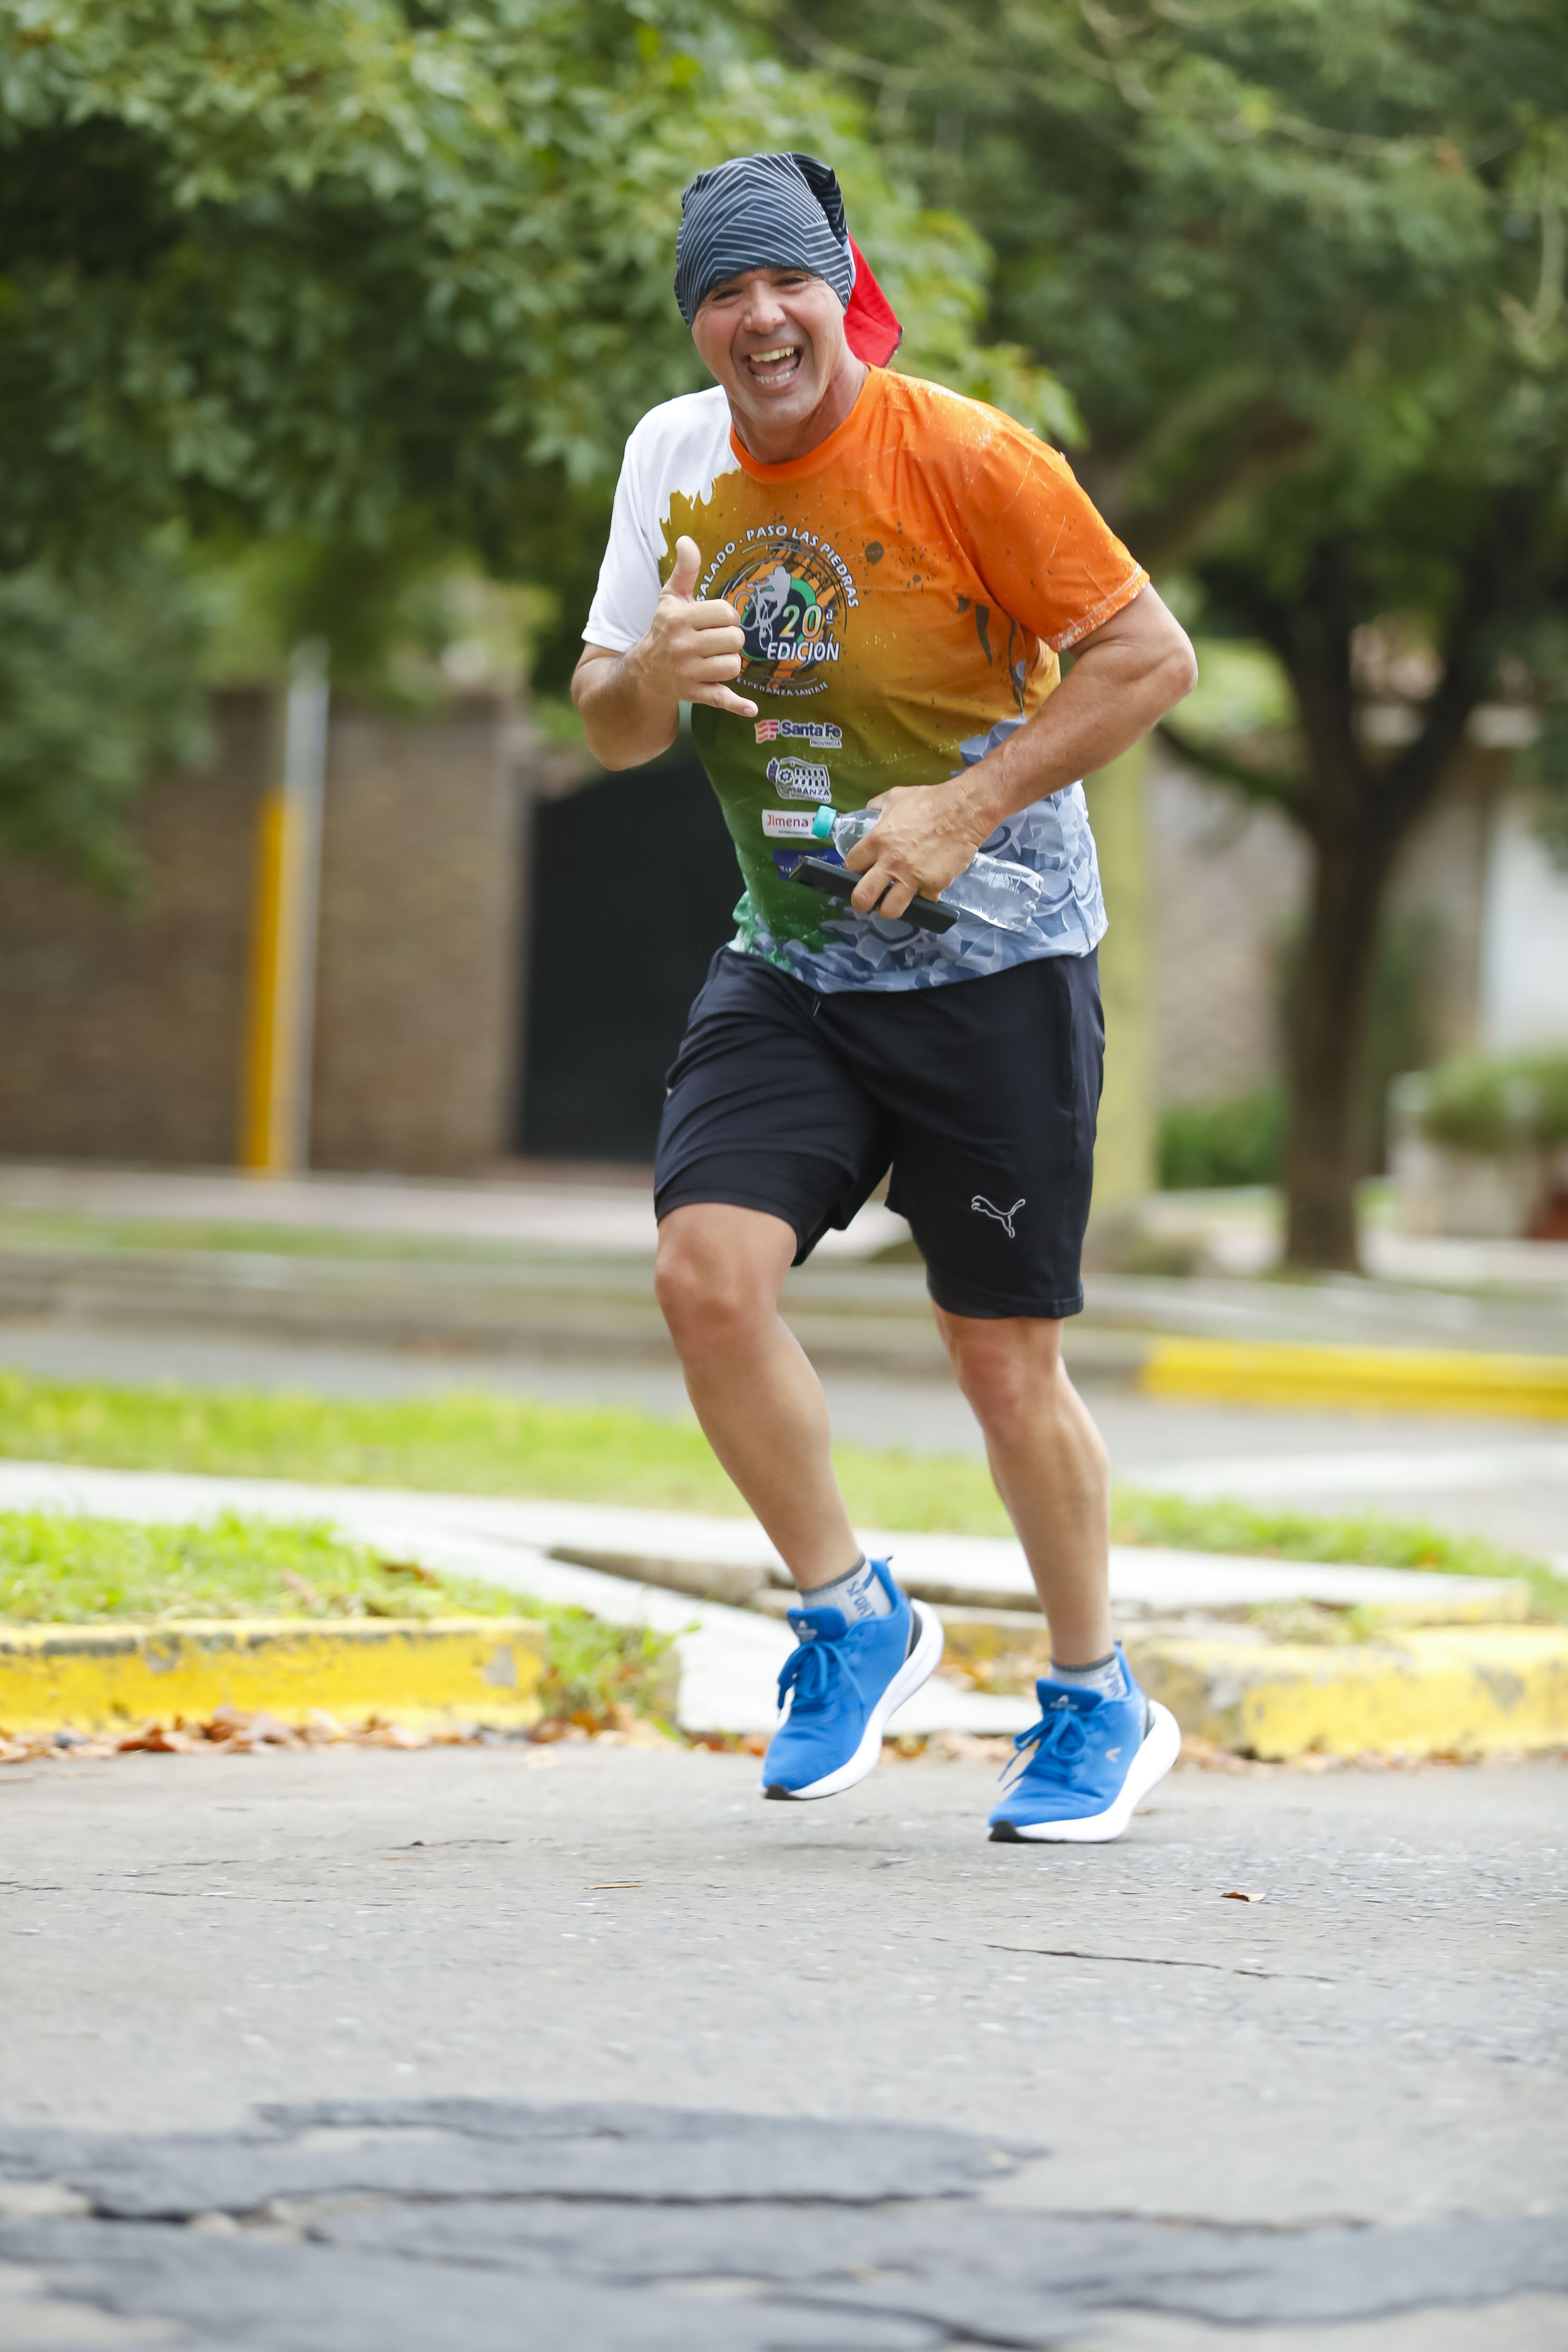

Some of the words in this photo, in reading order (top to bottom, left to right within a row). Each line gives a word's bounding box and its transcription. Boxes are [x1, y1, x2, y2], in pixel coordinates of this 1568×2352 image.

[695, 541, 736, 601] SALADO
[746, 524, 788, 542] PASO
[792, 527, 820, 547] LAS
[819, 542, 859, 607] PIEDRAS
[781, 721, 823, 737] Santa
[825, 724, 841, 737] Fe
[767, 815, 808, 827] Jimena
